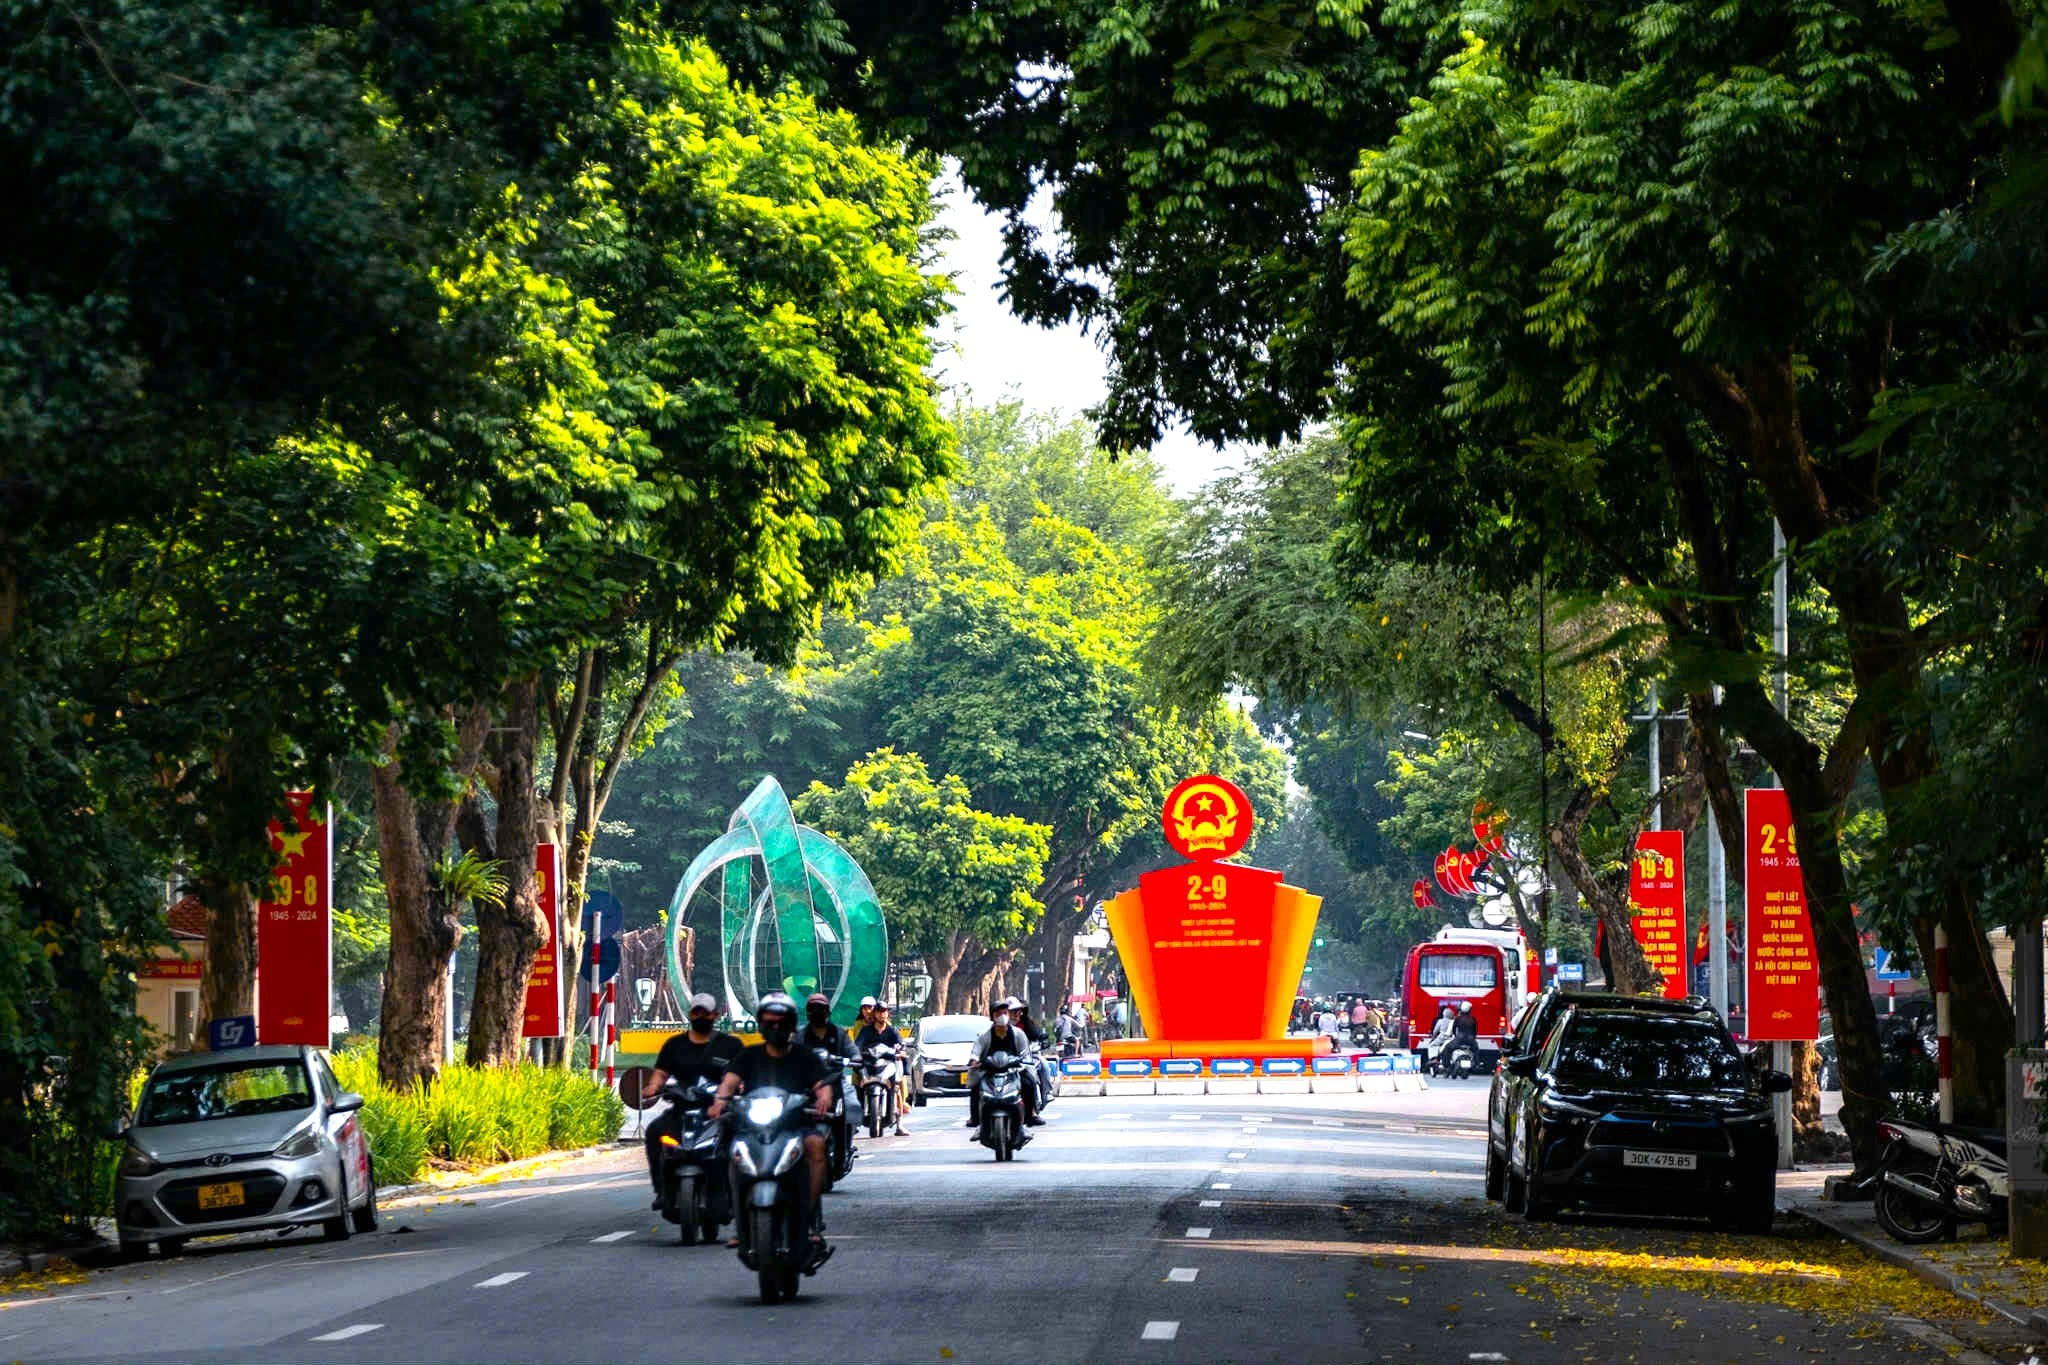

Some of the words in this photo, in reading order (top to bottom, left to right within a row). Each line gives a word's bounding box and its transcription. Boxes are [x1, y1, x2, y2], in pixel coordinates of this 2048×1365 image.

[1761, 824, 1797, 854] 2-9
[1760, 857, 1779, 866] 1945
[1786, 857, 1800, 866] 202
[1639, 857, 1674, 879] 19-8
[1187, 875, 1227, 900] 2-9
[1786, 890, 1799, 902] LIỆT
[1661, 907, 1674, 917] LIỆT
[1763, 904, 1781, 915] CHÀO
[270, 911, 289, 920] 1945
[297, 911, 317, 920] 2024
[1780, 918, 1795, 929] NĂM
[1765, 960, 1776, 972] HỘI
[1765, 975, 1779, 985] VIỆT
[1780, 975, 1797, 985] NAM
